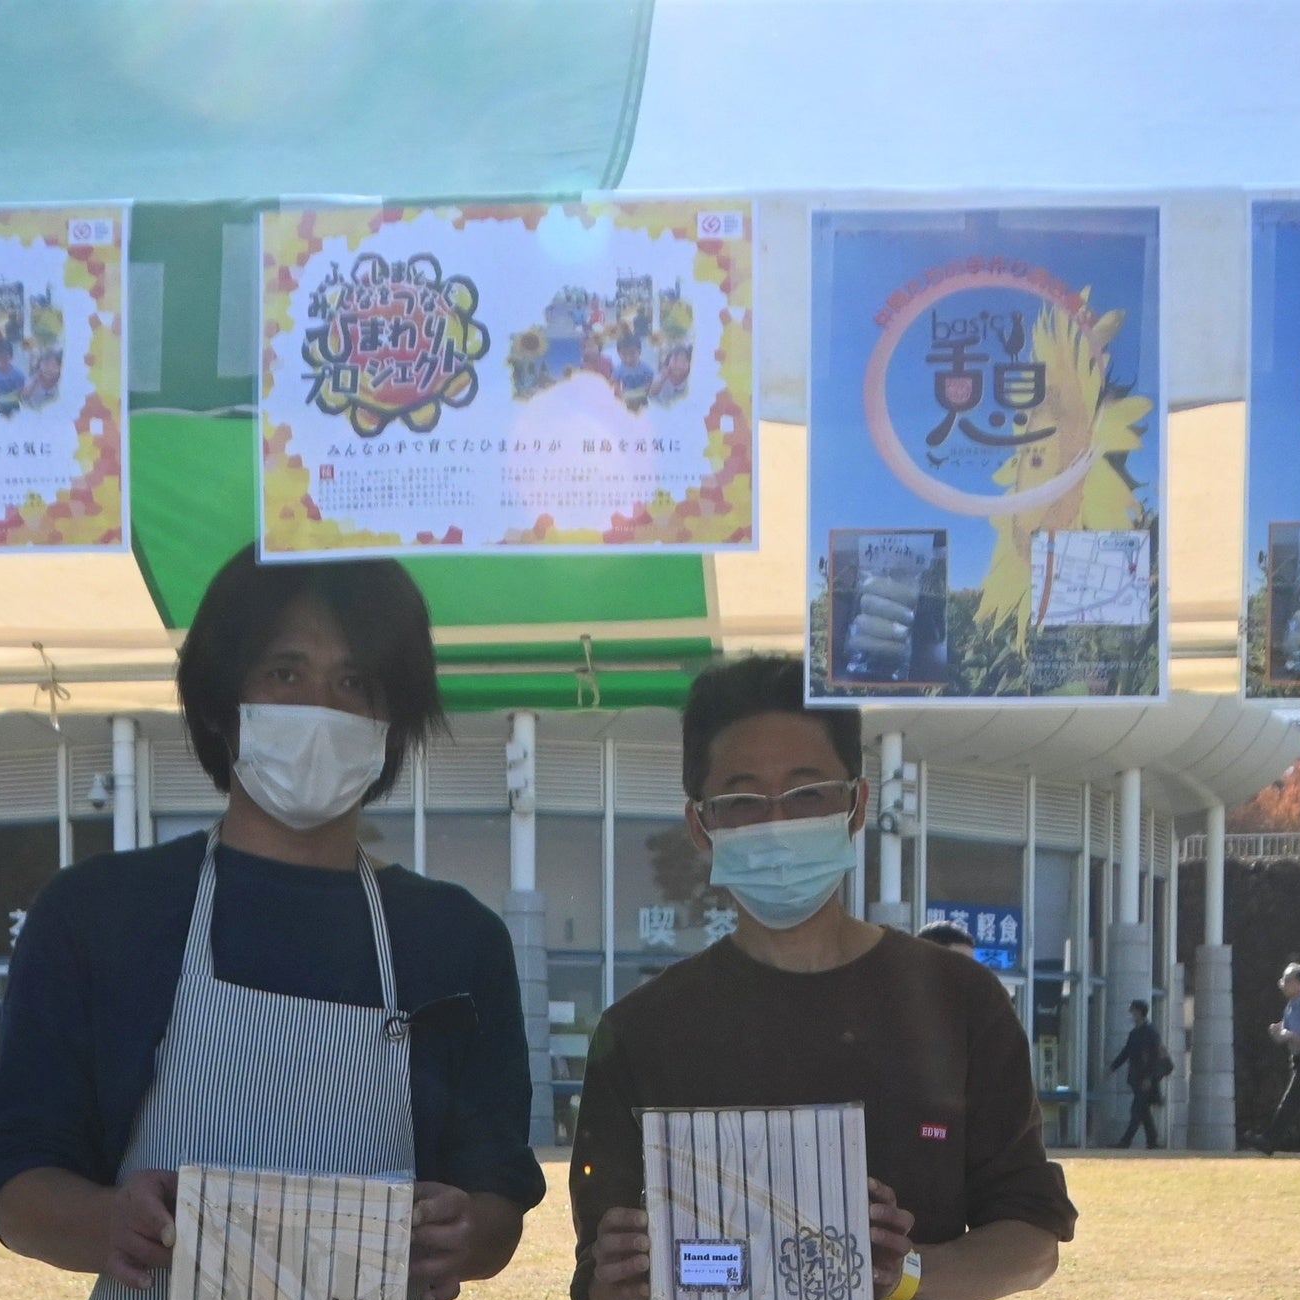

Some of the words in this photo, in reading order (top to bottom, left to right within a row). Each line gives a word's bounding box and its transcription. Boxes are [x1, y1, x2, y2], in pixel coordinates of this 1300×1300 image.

[327, 438, 562, 458] みんなの手で育てたひまわりが
[583, 438, 681, 454] 福島を元気に
[977, 911, 1019, 944] 軽食
[922, 1126, 947, 1139] EDWIN
[683, 1253, 710, 1261] Hand
